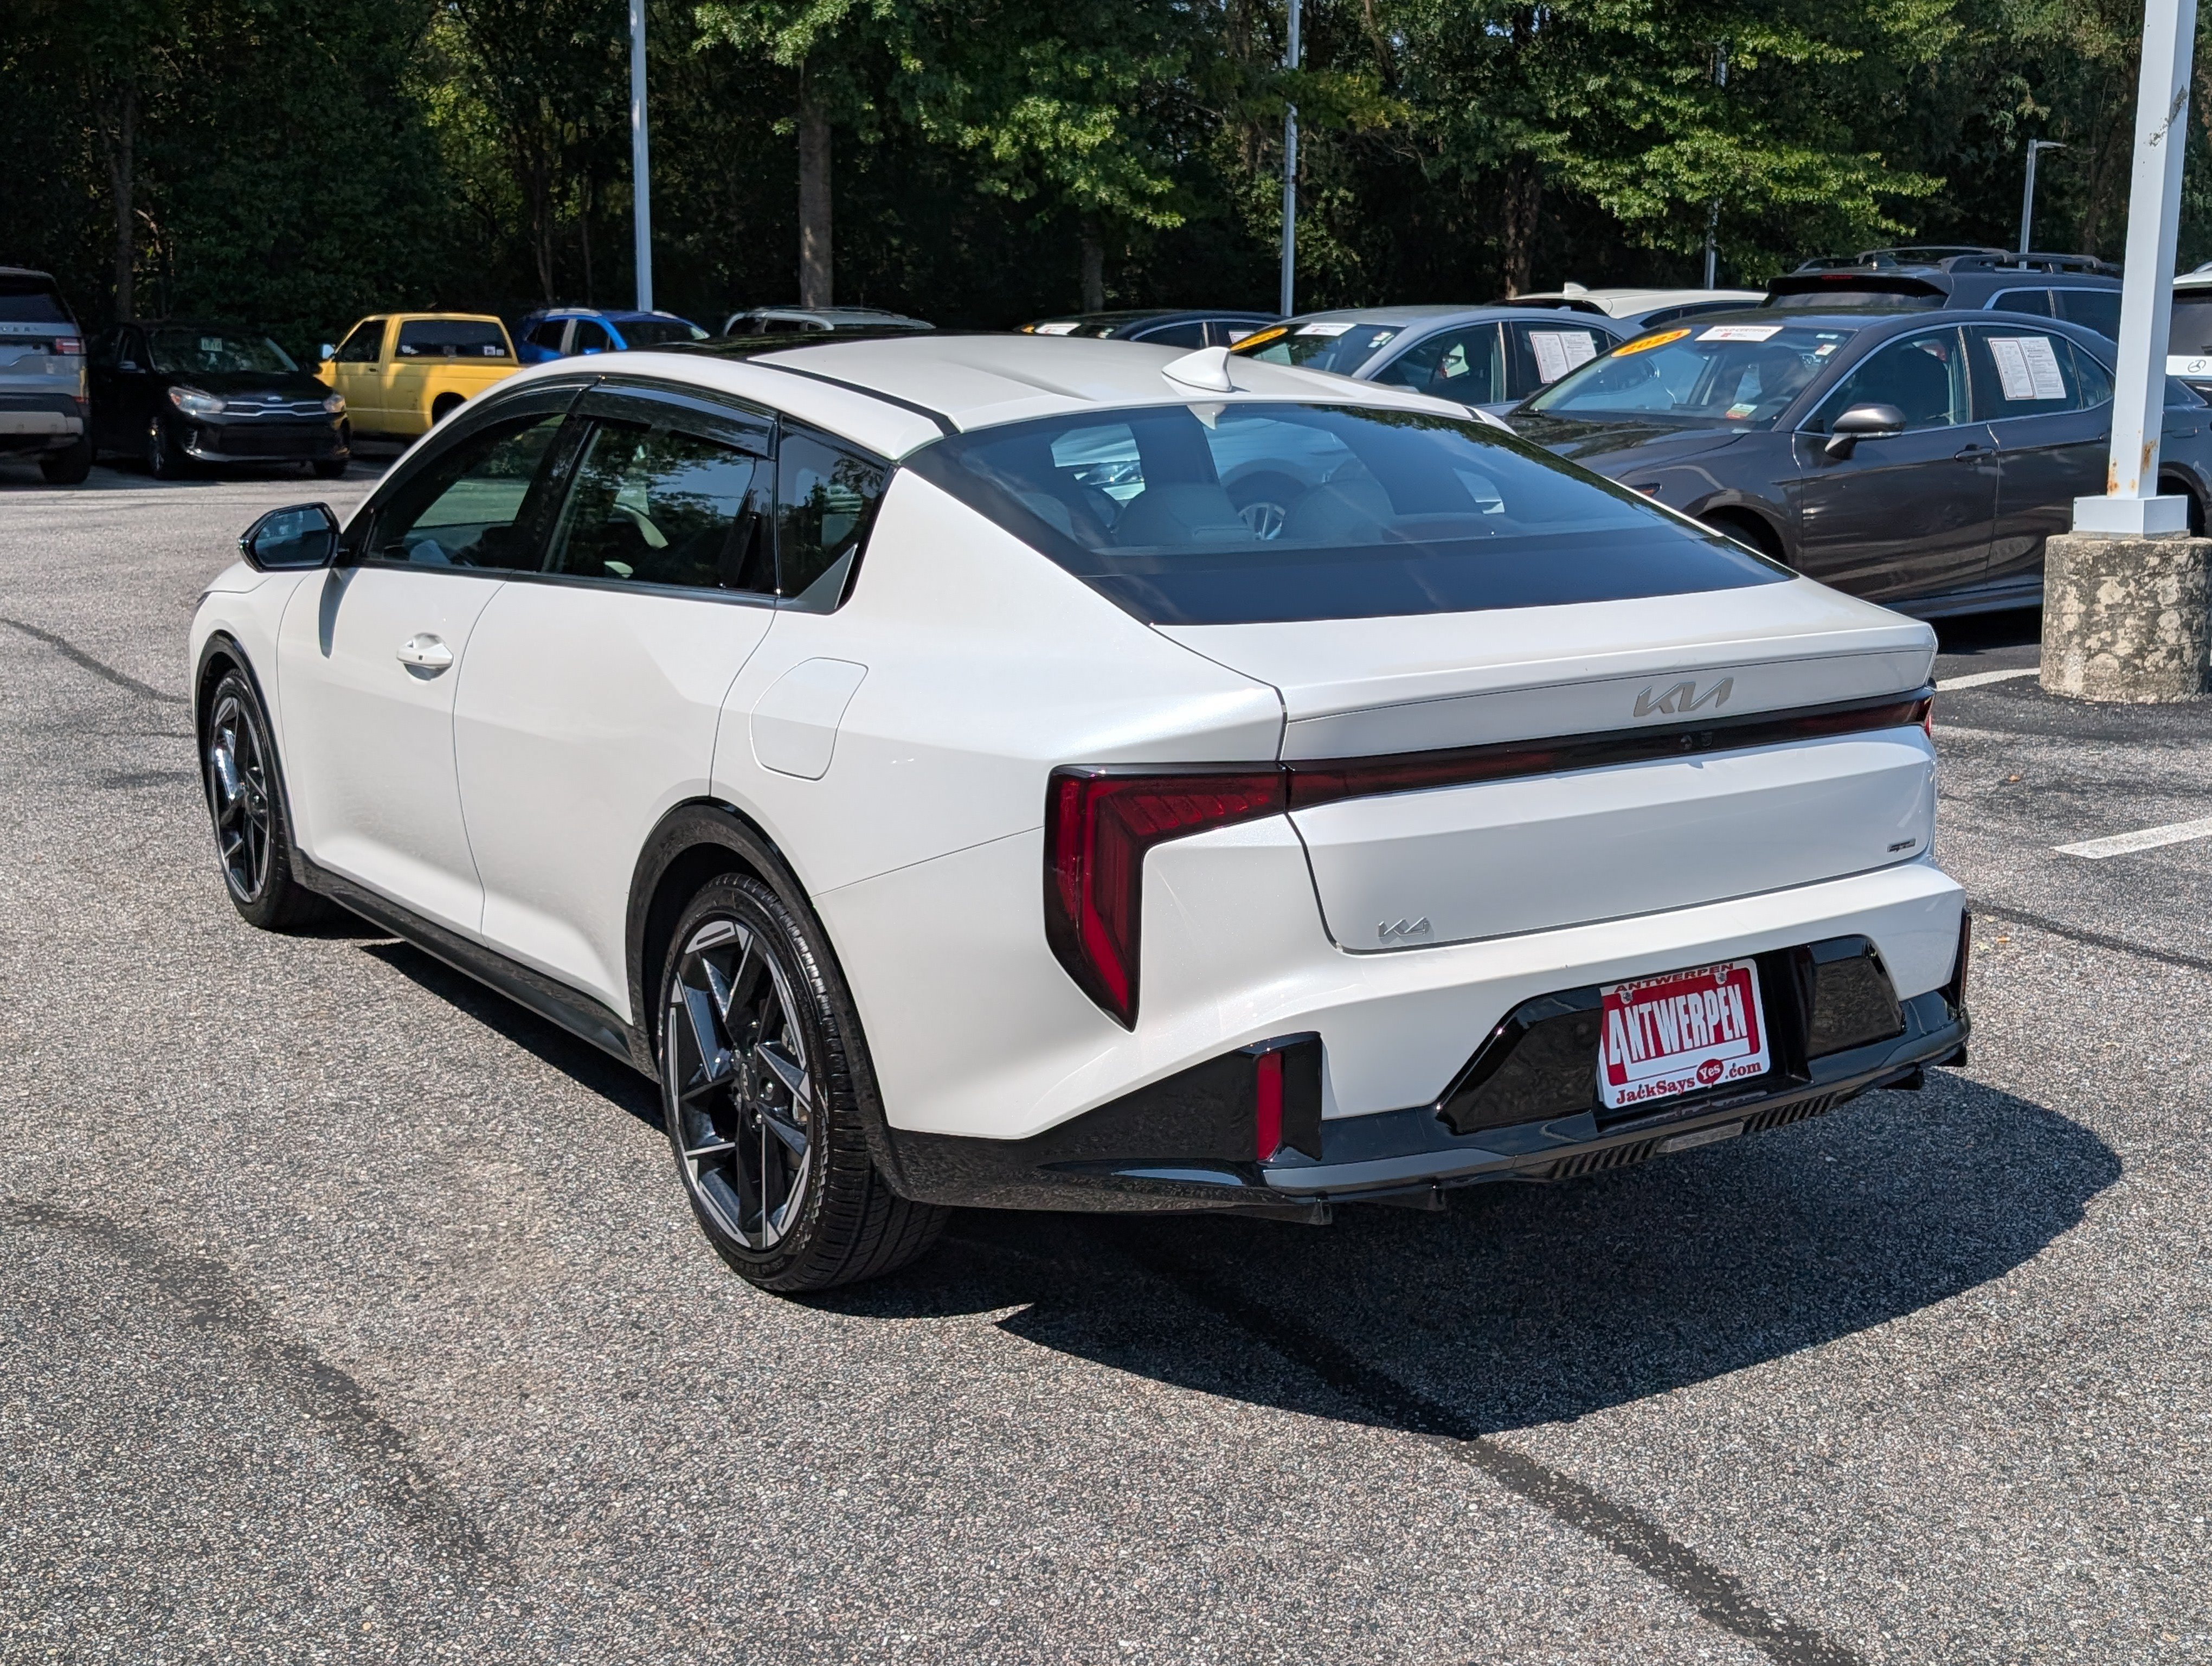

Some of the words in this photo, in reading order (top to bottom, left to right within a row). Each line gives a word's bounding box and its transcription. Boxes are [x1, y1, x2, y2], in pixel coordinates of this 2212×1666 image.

[1377, 916, 1430, 938] K4
[1615, 963, 1733, 992] ANTWERPEN
[1608, 984, 1747, 1066] ANTWERPEN
